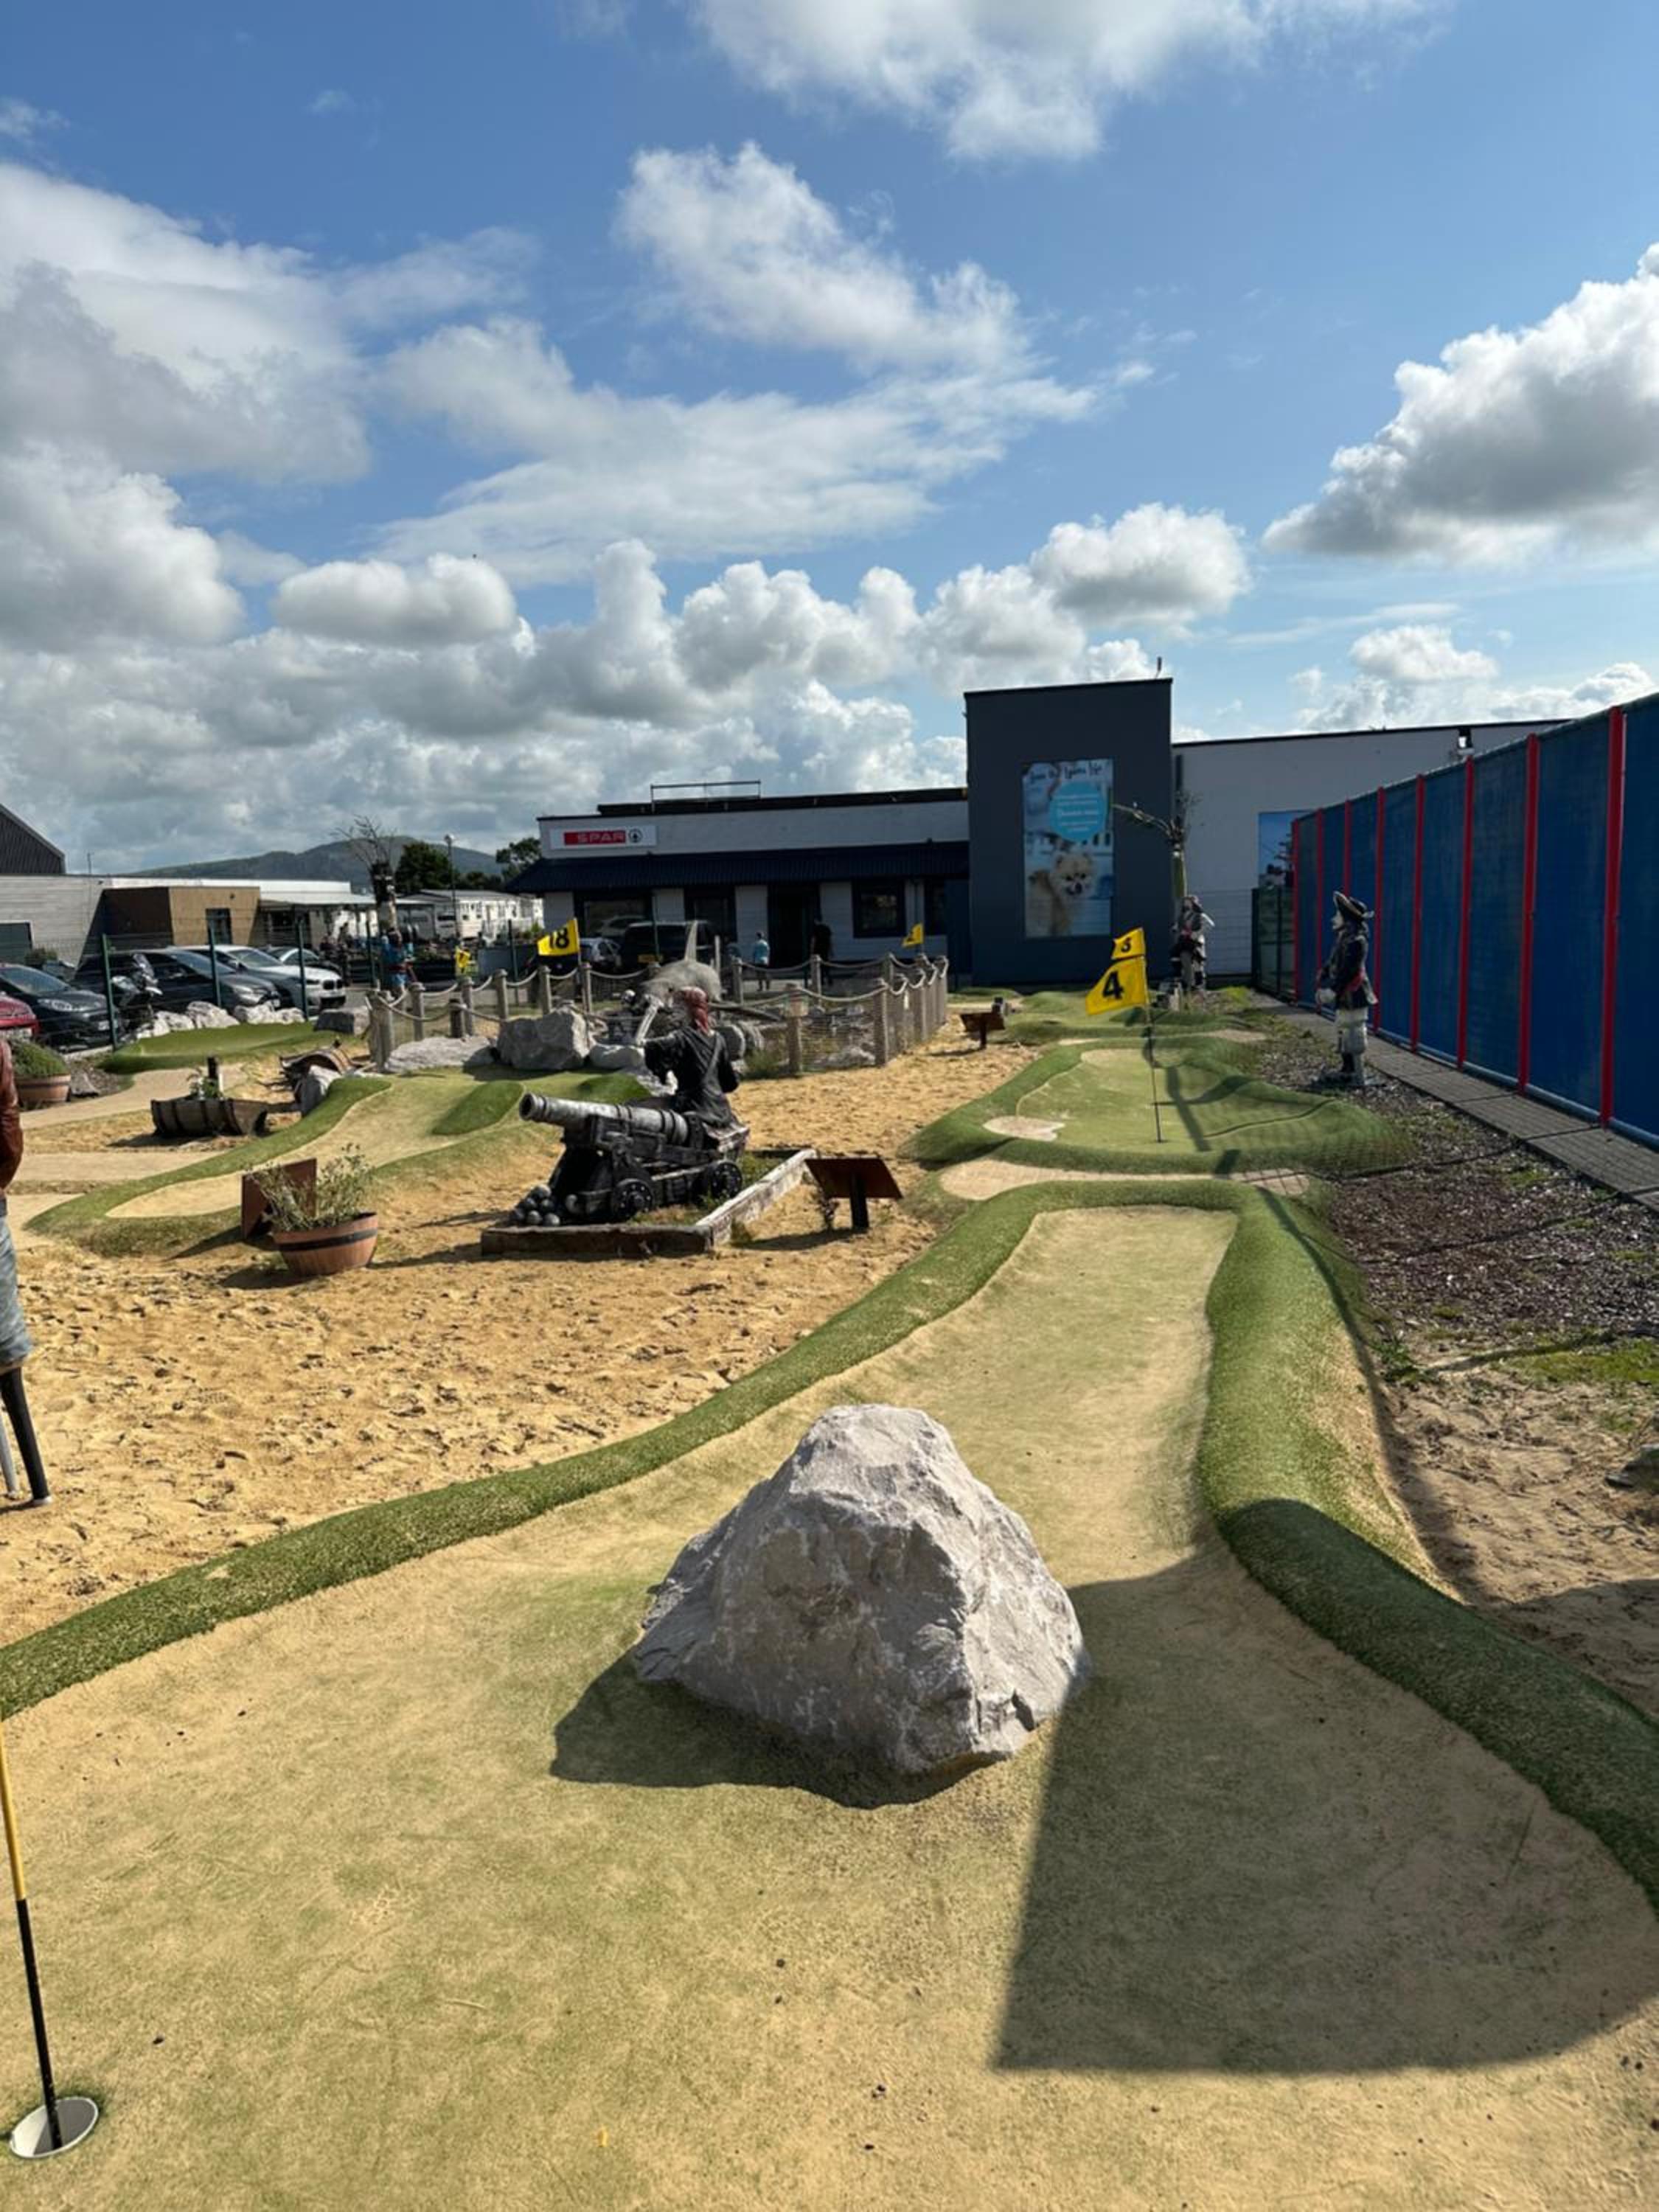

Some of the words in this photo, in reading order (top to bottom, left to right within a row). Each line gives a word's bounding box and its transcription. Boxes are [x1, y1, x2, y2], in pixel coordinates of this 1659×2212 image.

[577, 832, 625, 844] SPAR
[549, 927, 570, 949] 18
[1102, 970, 1124, 1000] 4
